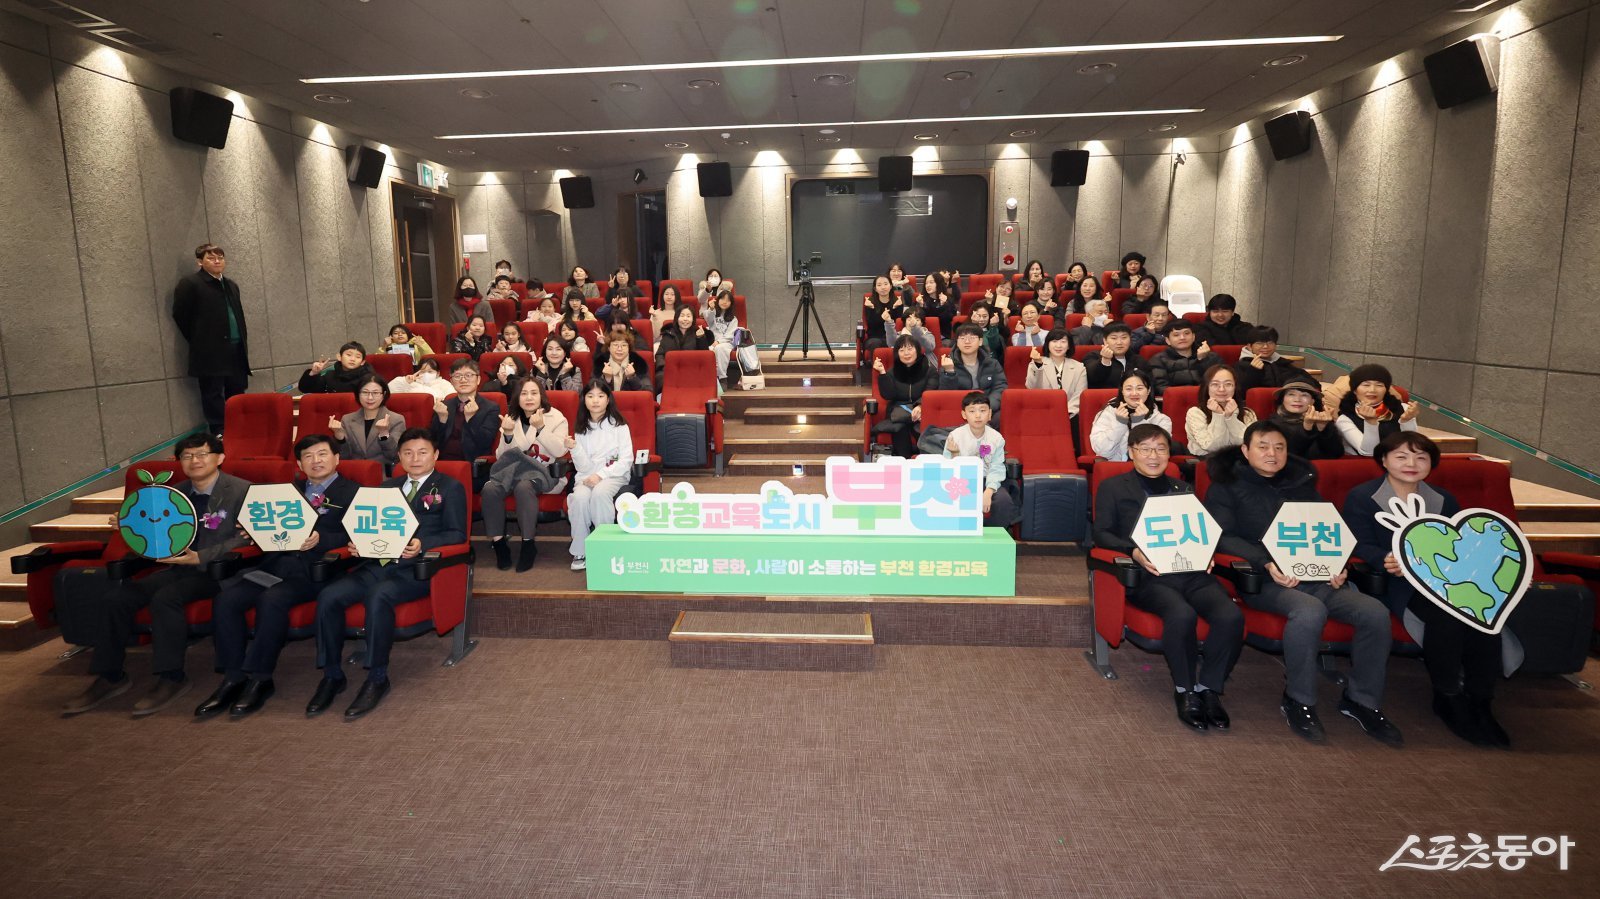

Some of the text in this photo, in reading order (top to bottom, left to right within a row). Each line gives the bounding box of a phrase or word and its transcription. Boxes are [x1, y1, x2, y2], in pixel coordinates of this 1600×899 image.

[643, 463, 978, 530] 환경교육도시 부천
[247, 500, 305, 531] 환경
[353, 505, 406, 536] 교육
[1144, 512, 1209, 548] 도시
[1276, 521, 1343, 557] 부천
[627, 561, 649, 570] 부천시
[659, 558, 988, 577] 자연과 문화, 사람이 소통하는 부천 환경교육
